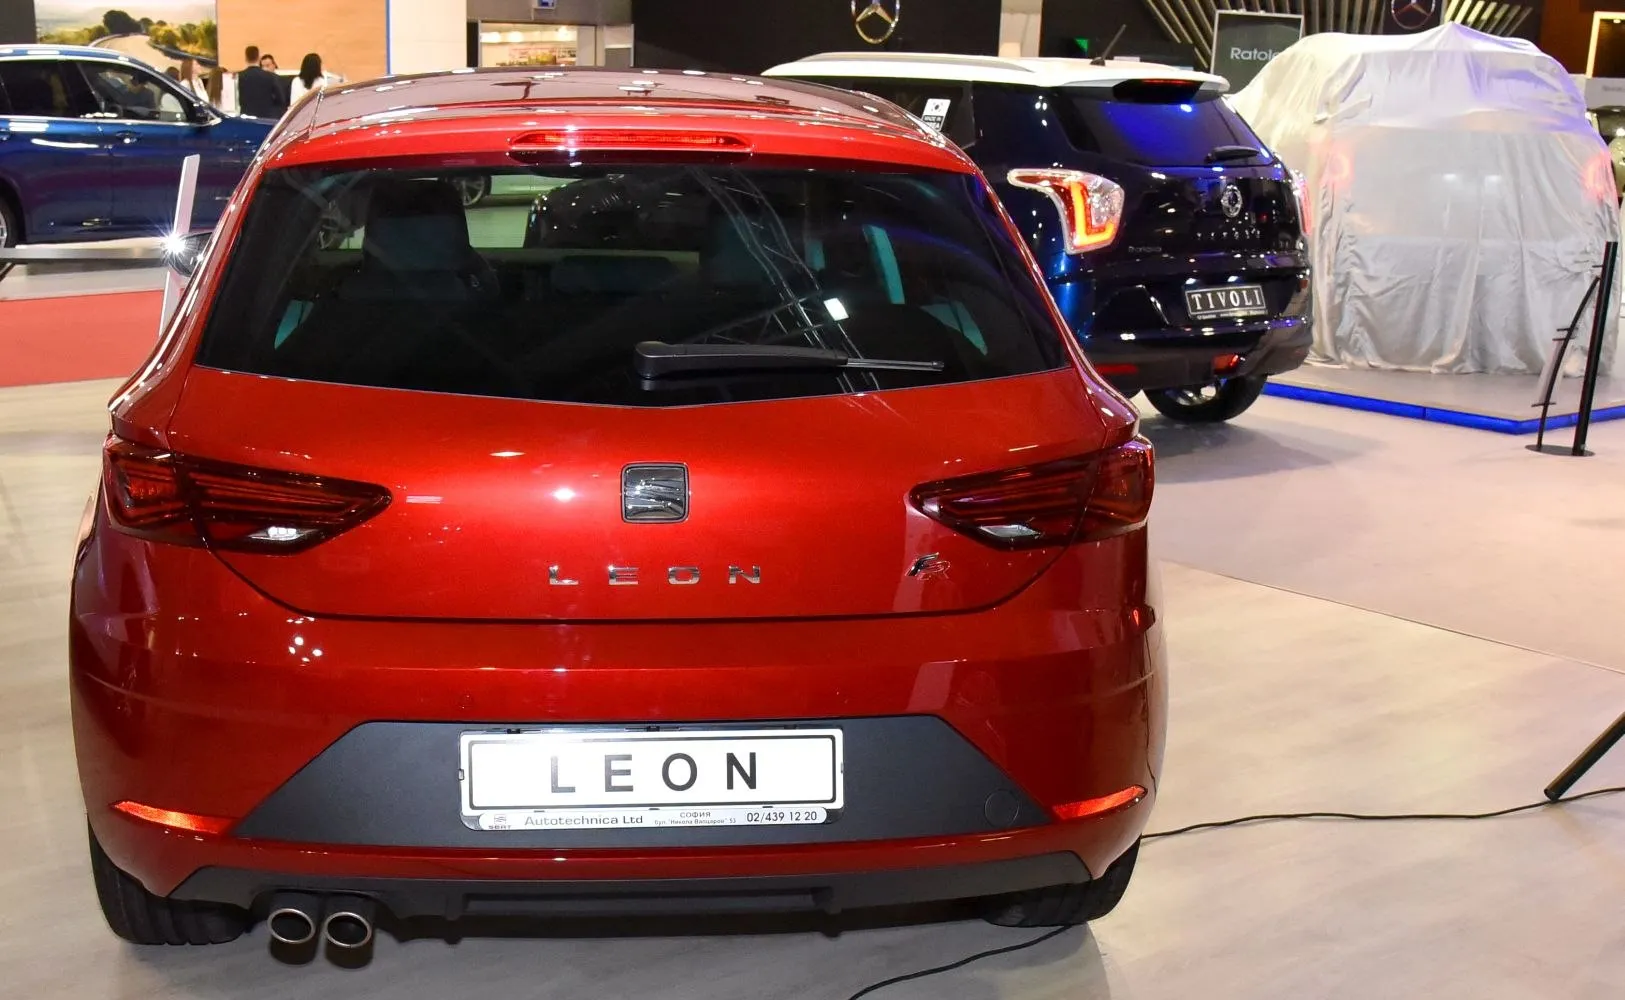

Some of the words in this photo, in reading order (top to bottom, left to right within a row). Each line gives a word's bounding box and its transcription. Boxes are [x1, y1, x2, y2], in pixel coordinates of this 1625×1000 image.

[1191, 290, 1261, 310] TIVOLI
[548, 565, 761, 585] LEON
[550, 751, 757, 794] LEON
[524, 814, 619, 826] Autotechnica
[622, 815, 643, 824] Ltd
[746, 811, 785, 822] 02/439
[789, 811, 801, 821] 12
[804, 811, 818, 821] 20
